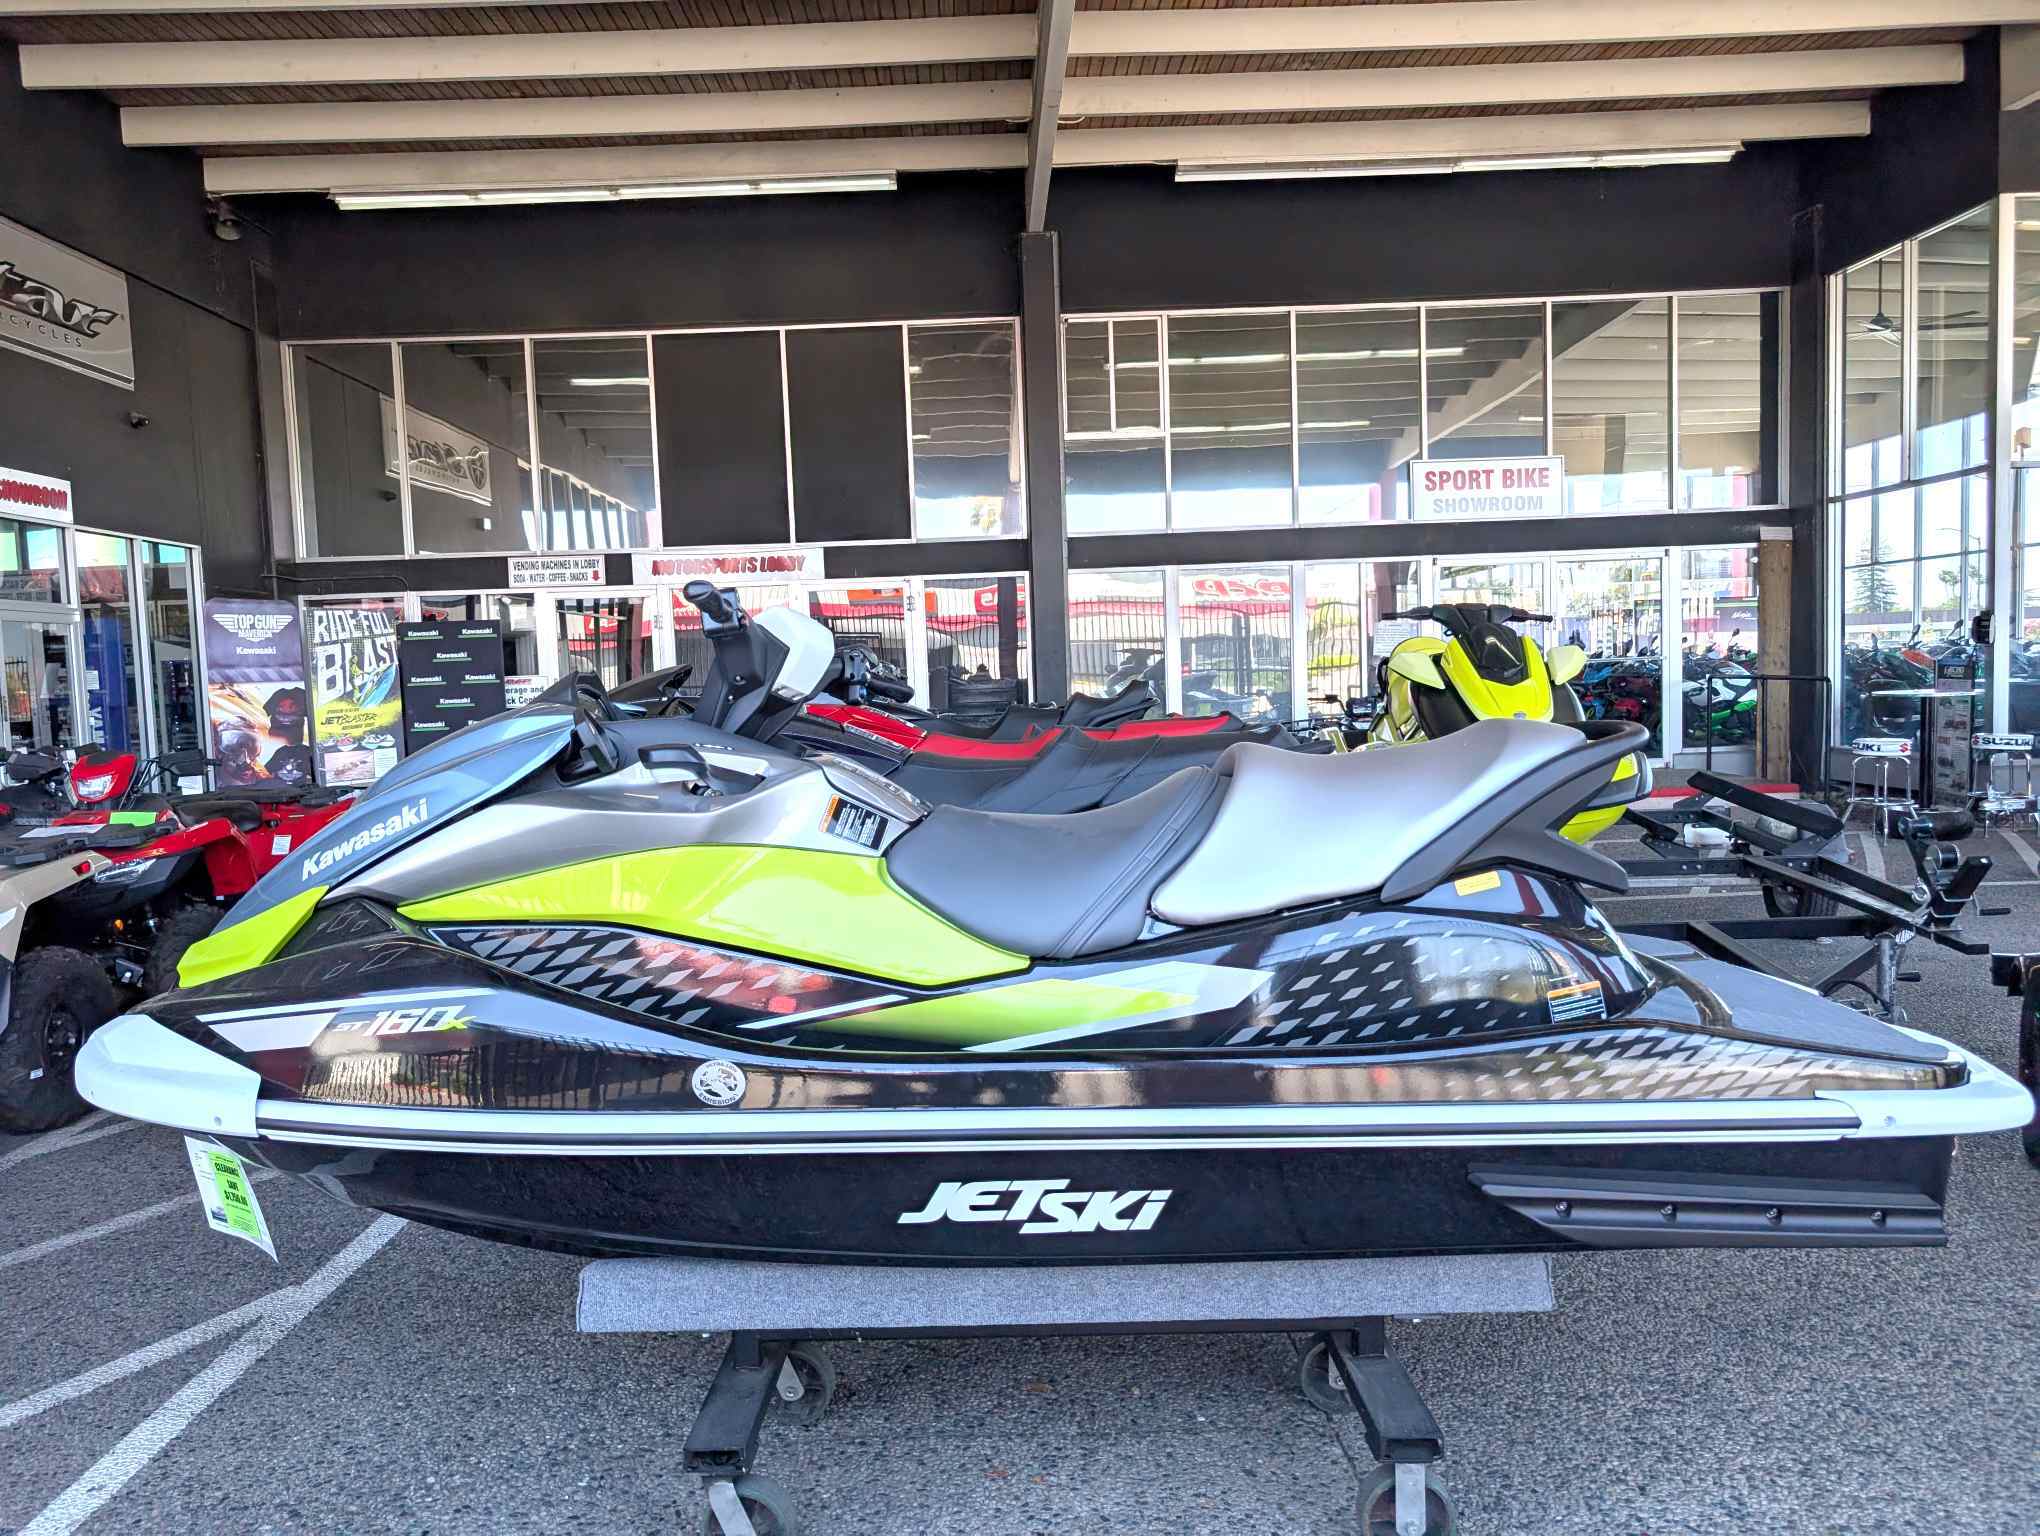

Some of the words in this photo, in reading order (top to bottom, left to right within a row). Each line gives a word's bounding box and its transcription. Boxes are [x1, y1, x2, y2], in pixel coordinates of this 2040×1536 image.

[0, 311, 82, 347] CYCLES
[1424, 469, 1494, 492] SPORT
[1502, 467, 1550, 489] BIKE
[1433, 496, 1544, 513] SHOWROOM
[512, 561, 539, 571] VENDING
[540, 560, 571, 570] MACHINES
[573, 560, 579, 569] IN
[580, 559, 600, 569] LOBBY
[652, 556, 758, 576] MOTORSPORTS
[759, 555, 807, 573] LOBBY
[513, 574, 526, 584] SODA
[529, 573, 545, 583] WATER
[548, 573, 566, 582] COFFEE
[569, 572, 588, 582] SNACKS
[234, 614, 254, 629] TOP
[254, 614, 278, 629] GUN
[313, 610, 362, 643] RIDE
[358, 610, 394, 635] FULL
[236, 646, 277, 655] Kawasaki
[316, 635, 399, 706] BLAST
[302, 798, 428, 882] Kawasaki
